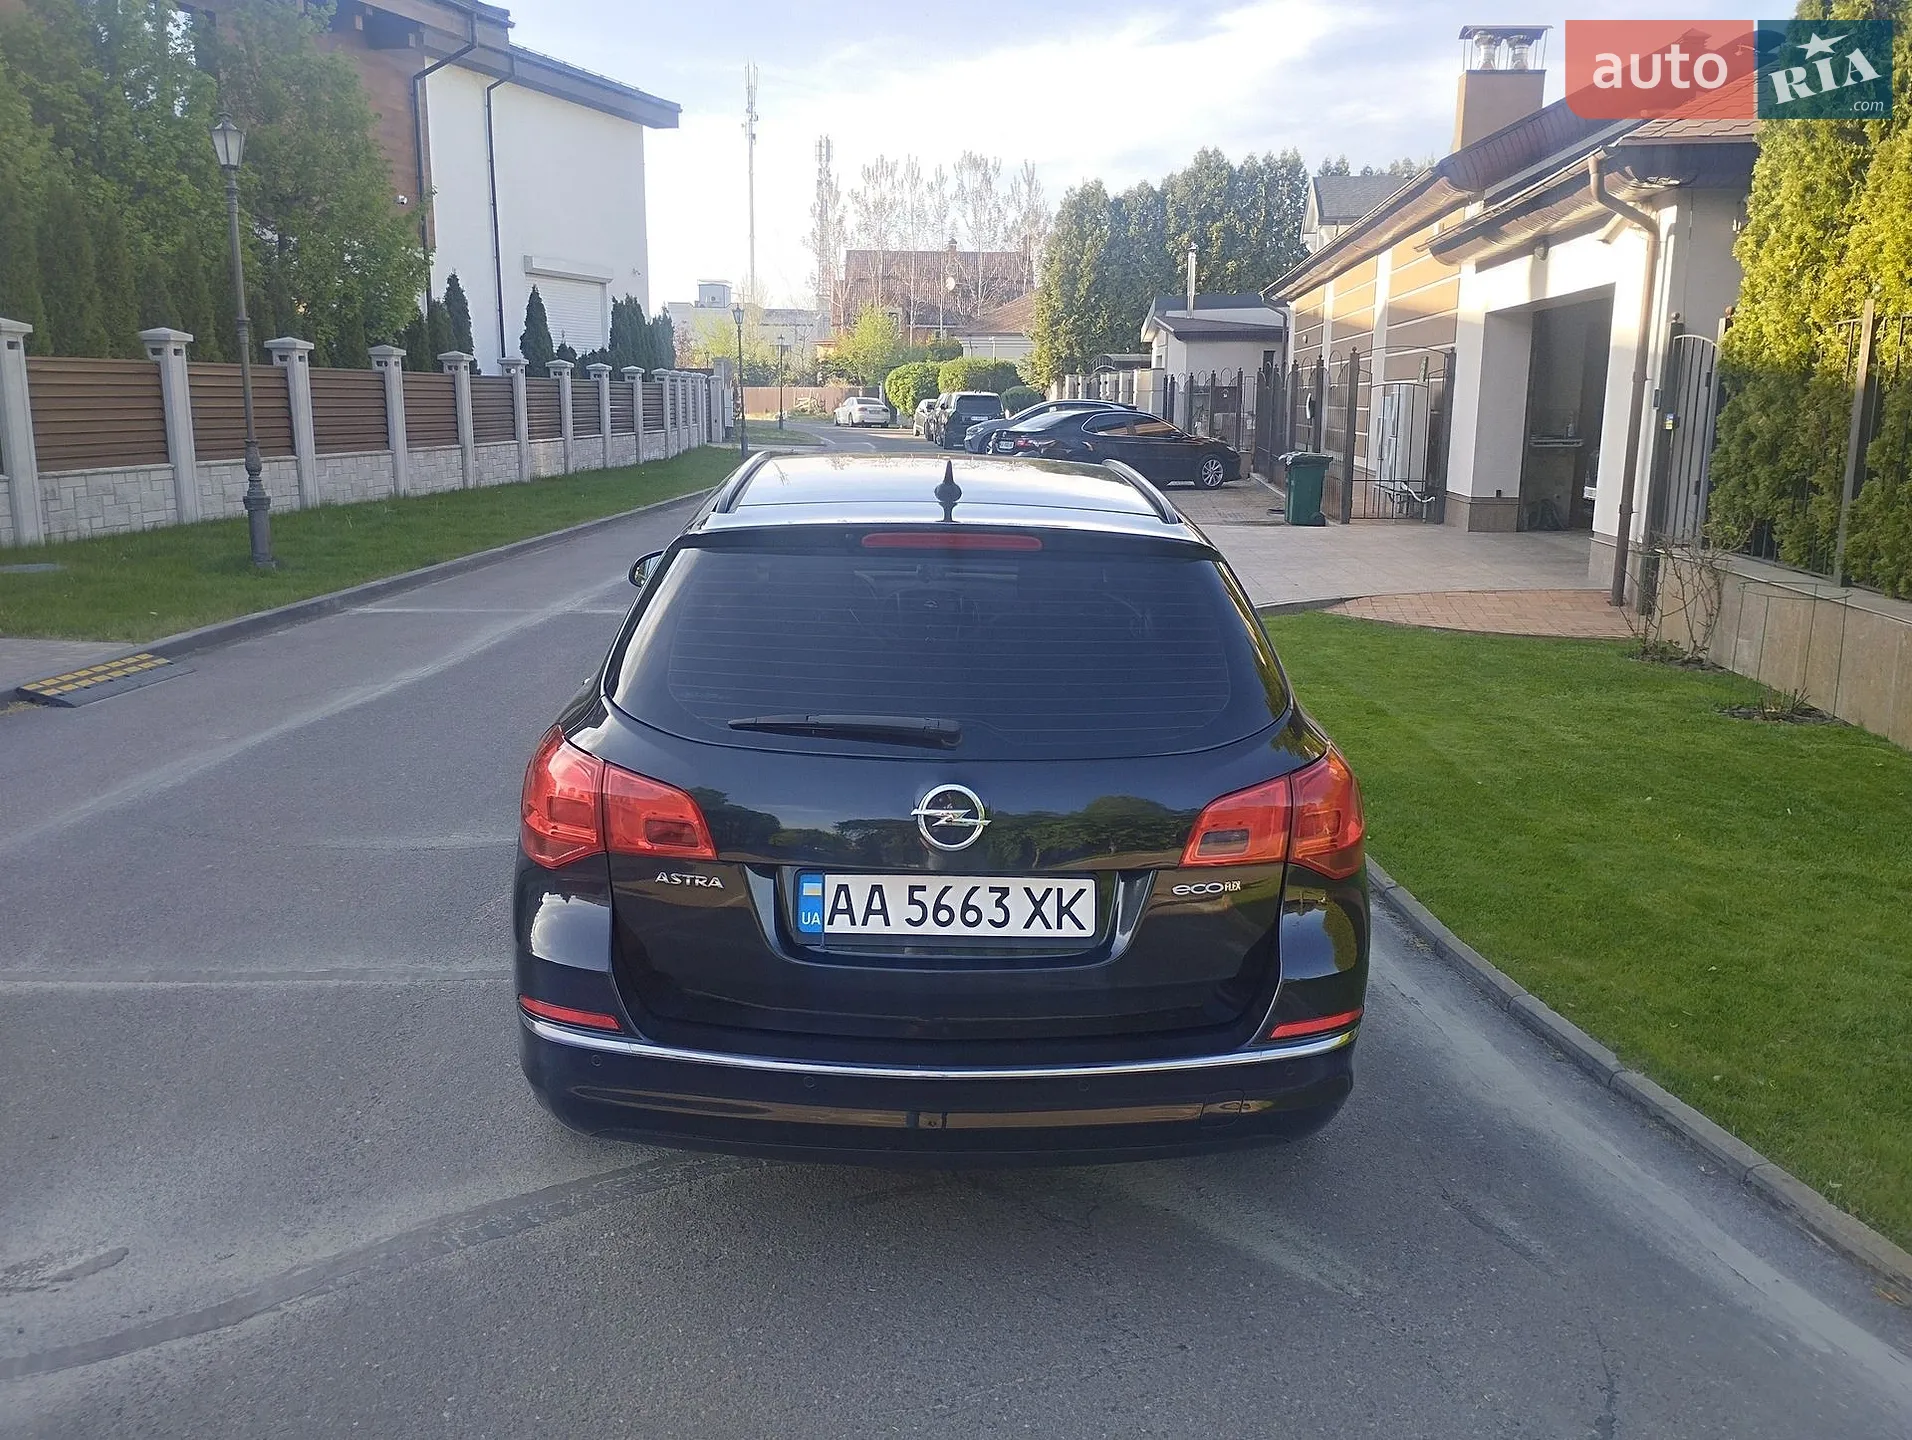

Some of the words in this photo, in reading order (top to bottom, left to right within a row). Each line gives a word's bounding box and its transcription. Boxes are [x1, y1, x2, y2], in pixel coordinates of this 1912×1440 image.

[654, 871, 725, 889] ASTRA
[827, 883, 891, 927] AA
[904, 884, 1010, 929] 5663
[1022, 886, 1087, 931] XK
[801, 911, 821, 925] UA
